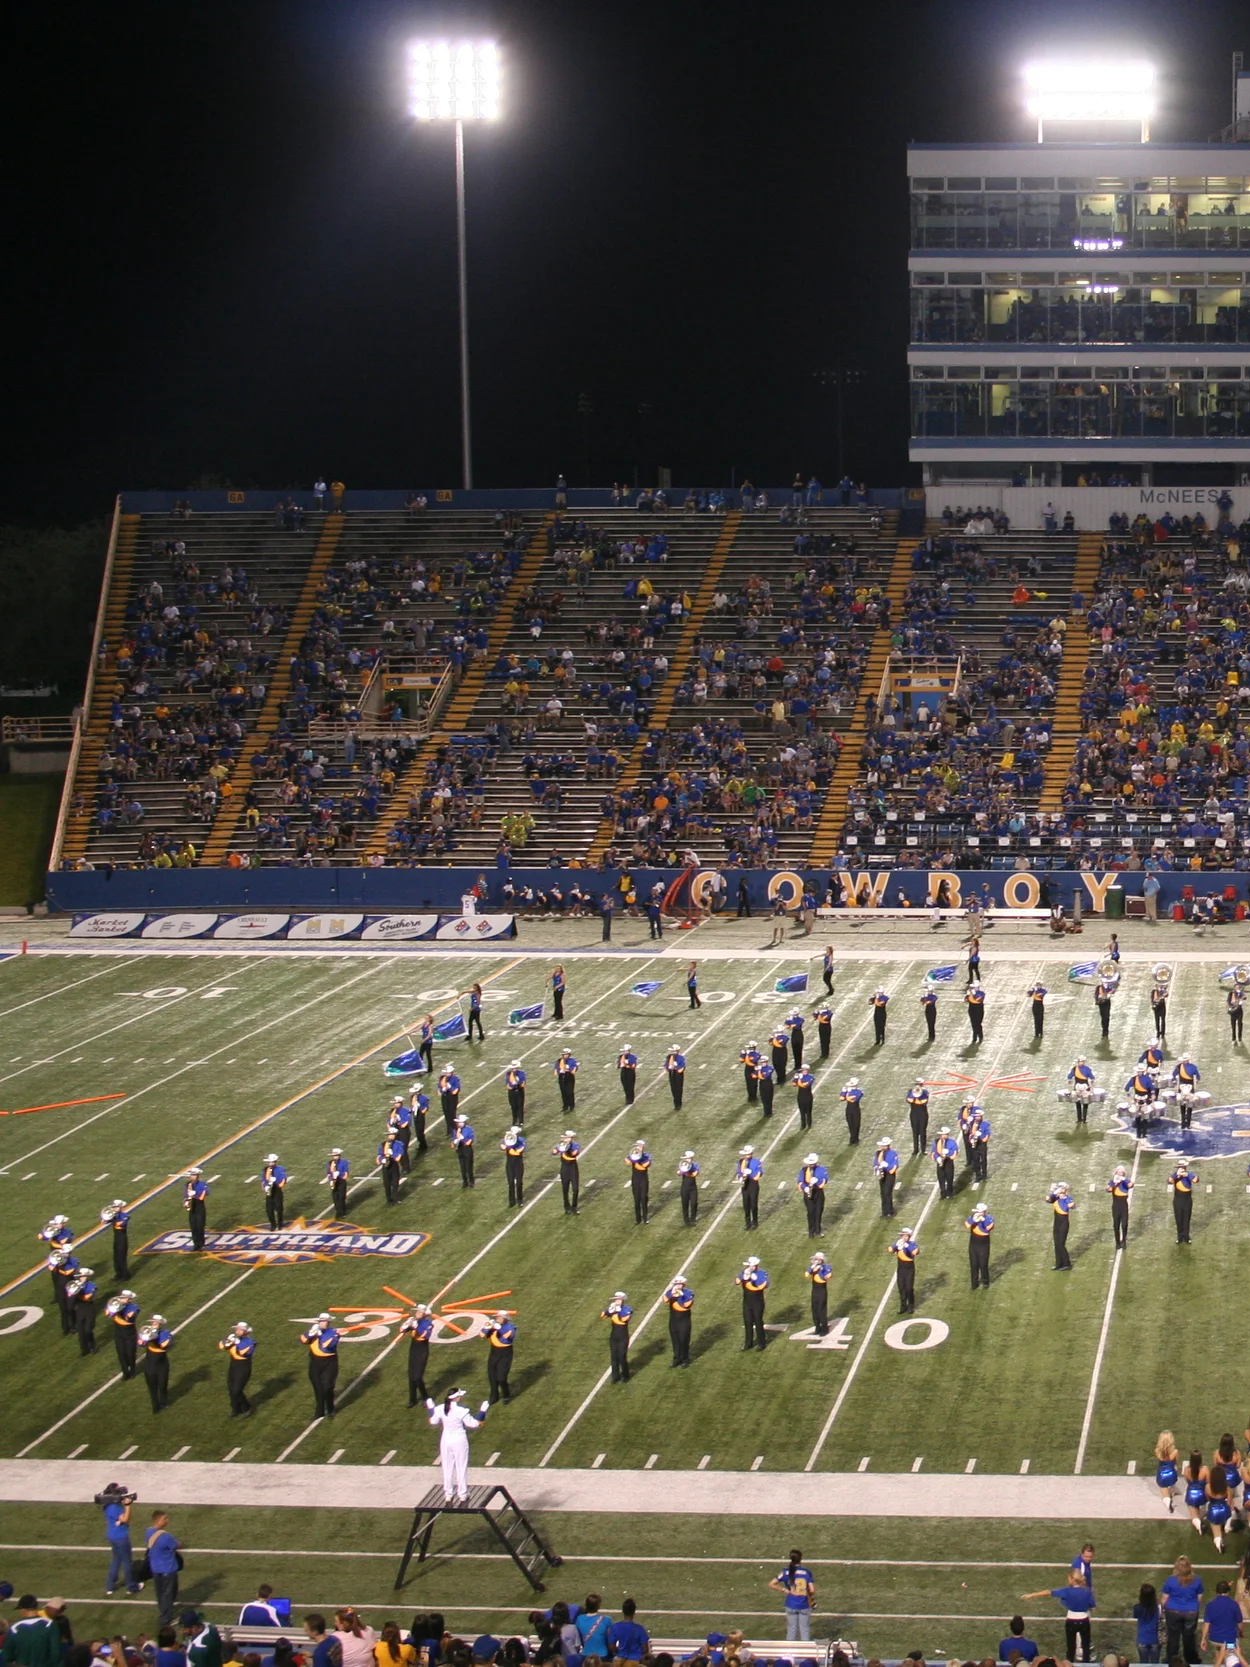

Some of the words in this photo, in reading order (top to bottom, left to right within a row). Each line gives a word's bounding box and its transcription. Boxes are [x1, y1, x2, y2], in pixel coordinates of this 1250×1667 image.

[691, 870, 1119, 913] COWBOY
[378, 919, 421, 932] Southern
[788, 1317, 951, 1350] 40
